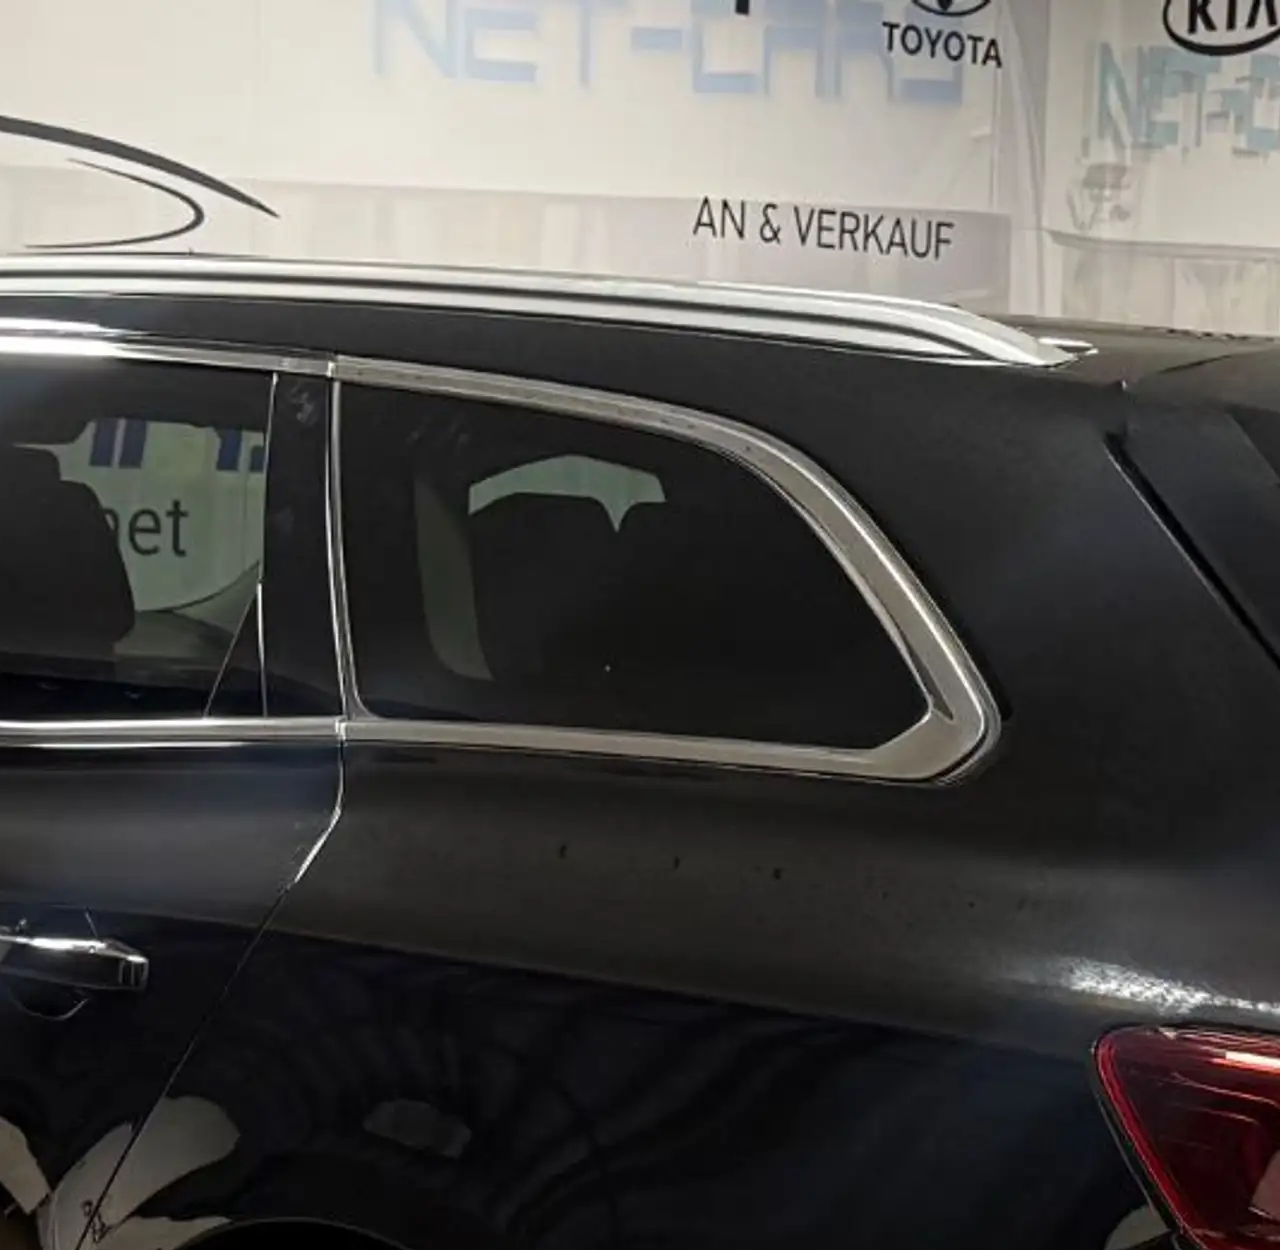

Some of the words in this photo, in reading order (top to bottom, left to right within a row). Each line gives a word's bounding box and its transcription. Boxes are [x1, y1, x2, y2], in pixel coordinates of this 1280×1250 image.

[1187, 0, 1277, 34] KIA
[882, 21, 1002, 68] TOYOTA
[693, 196, 747, 239] AN
[759, 203, 781, 244] &
[793, 206, 956, 260] VERKAUF
